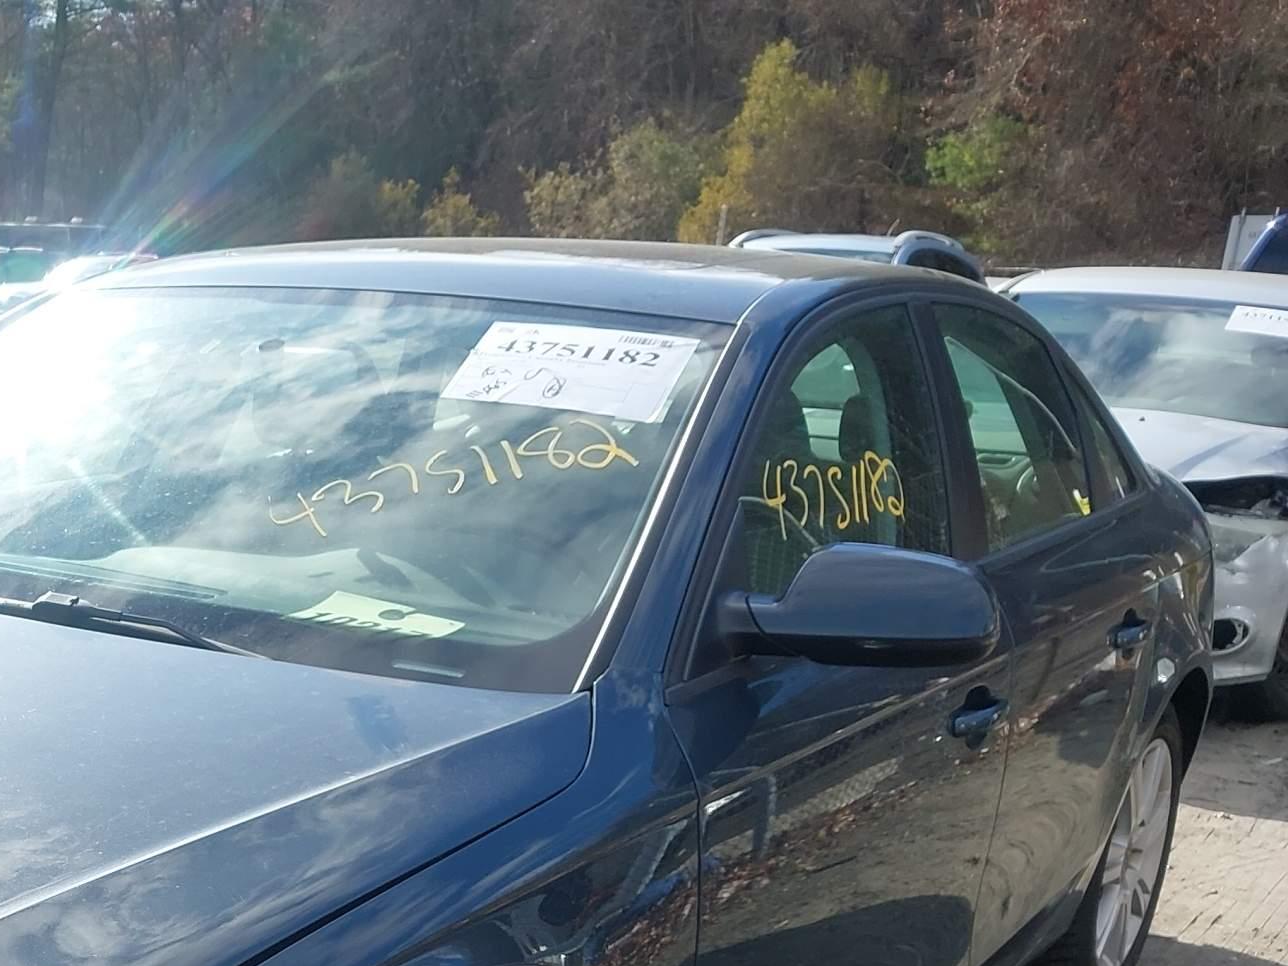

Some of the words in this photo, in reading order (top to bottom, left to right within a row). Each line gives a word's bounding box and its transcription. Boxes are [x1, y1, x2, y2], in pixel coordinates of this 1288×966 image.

[496, 338, 662, 368] 43751182
[267, 419, 640, 537] 43751182
[763, 450, 906, 541] 43751182
